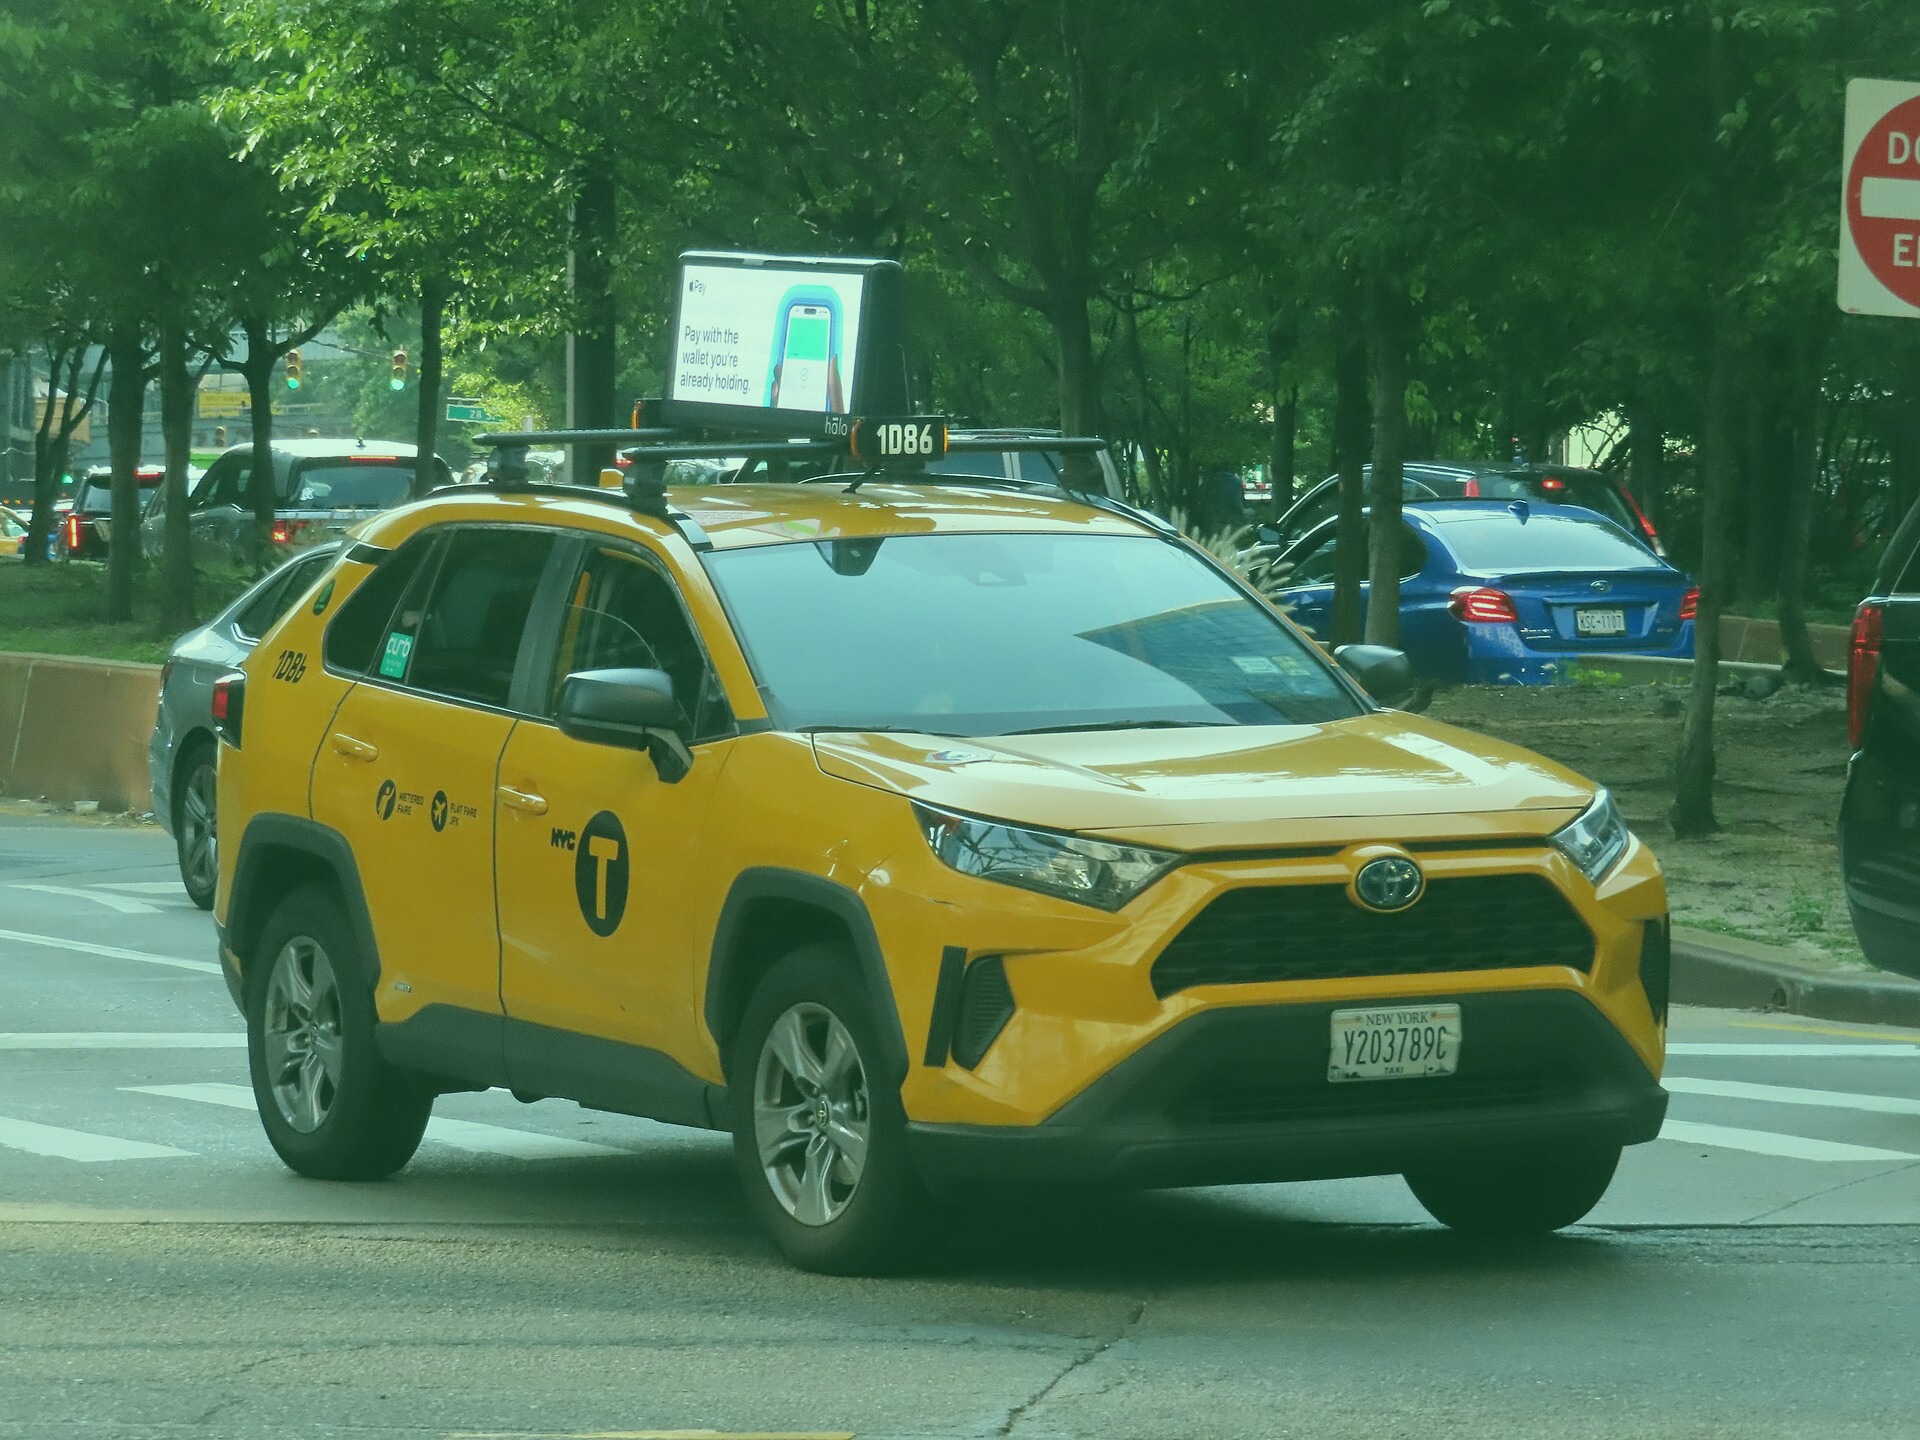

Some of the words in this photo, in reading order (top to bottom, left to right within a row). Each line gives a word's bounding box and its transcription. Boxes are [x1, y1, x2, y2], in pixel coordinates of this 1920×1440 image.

[1888, 131, 1920, 165] D
[684, 325, 701, 345] Pay
[702, 326, 722, 343] with
[723, 328, 739, 344] the
[682, 349, 709, 366] wallet
[710, 352, 738, 369] you're
[680, 371, 713, 392] already
[715, 373, 750, 395] holding.
[876, 423, 933, 455] 1D86
[386, 637, 411, 658] curb
[399, 792, 424, 806] METERED
[396, 803, 412, 816] FARE
[450, 802, 463, 814] FLAT
[463, 805, 478, 819] FARE
[551, 827, 576, 851] NYC
[1366, 1013, 1394, 1026] NEW
[1397, 1011, 1429, 1025] YORK
[1344, 1025, 1447, 1066] Y203789C
[1384, 1066, 1404, 1074] TAXI
